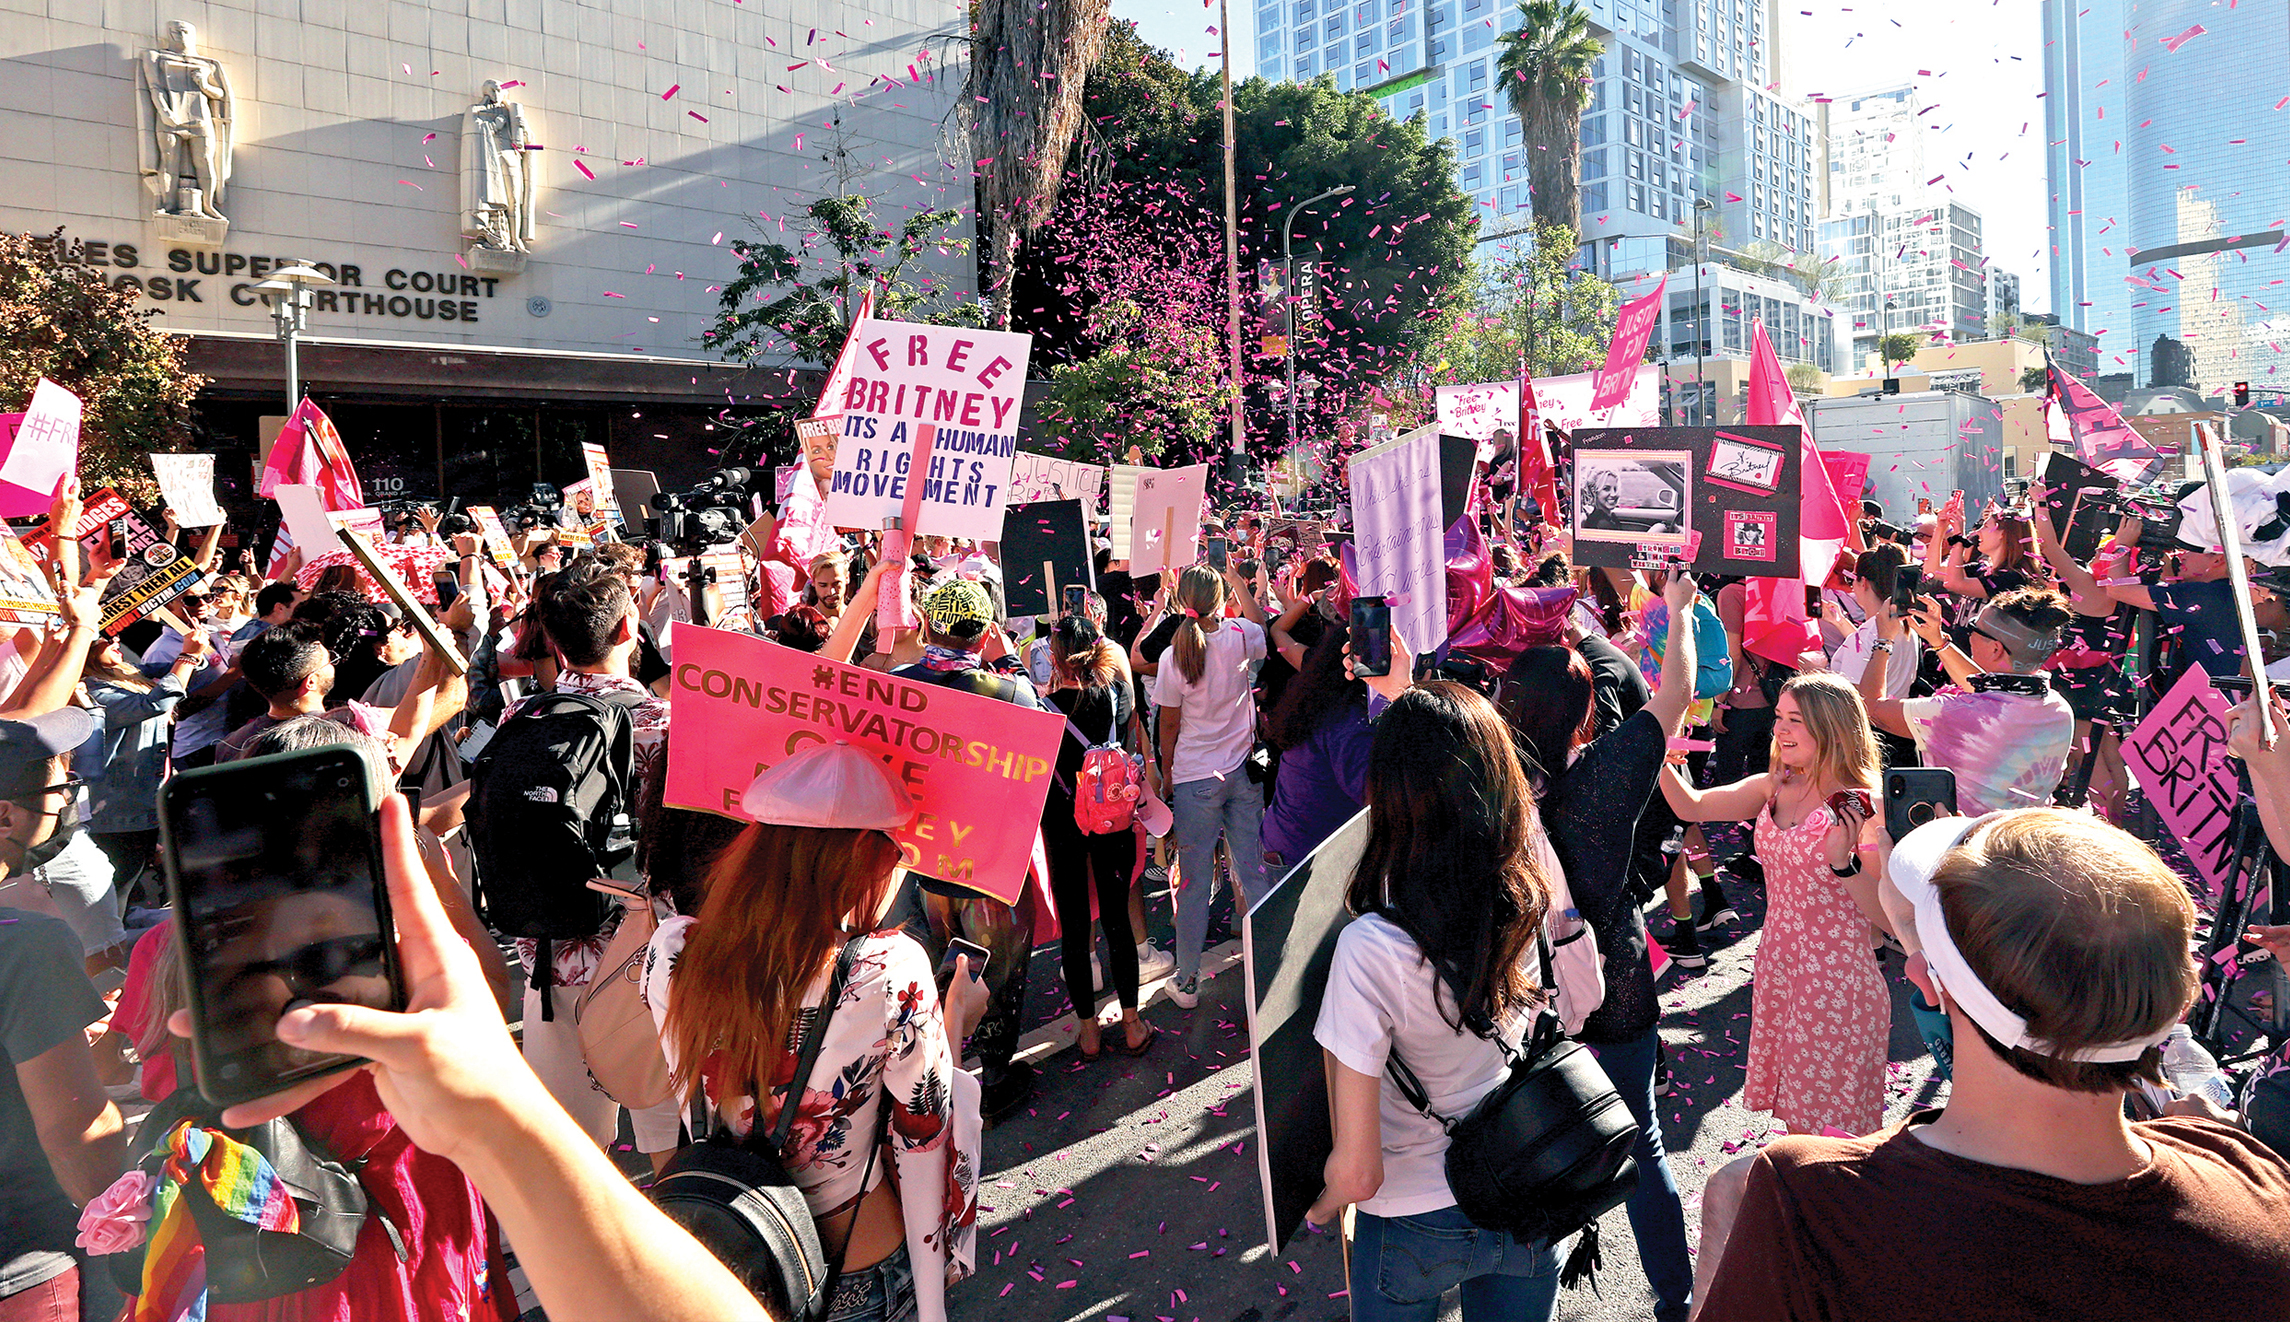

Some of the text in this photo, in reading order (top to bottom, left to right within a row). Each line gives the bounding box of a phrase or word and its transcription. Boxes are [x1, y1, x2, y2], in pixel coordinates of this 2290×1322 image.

[230, 283, 478, 322] CRTHOUSE
[385, 269, 499, 297] COURT
[1301, 261, 1314, 321] OPERA
[867, 335, 1013, 390] FREE
[845, 377, 1014, 429] BRITNEY
[1459, 395, 1478, 406] Free
[801, 420, 828, 438] FREE
[844, 415, 1015, 458] ITS A HUMAN
[1561, 418, 1583, 431] Free
[372, 477, 404, 491] 110
[856, 448, 985, 484] RIGHTS
[1020, 455, 1102, 494] JUSTICE
[831, 470, 998, 508] MOVEMENT
[76, 497, 128, 536] UDGES
[134, 574, 172, 598] THEM
[168, 560, 192, 577] ALL
[812, 664, 928, 713] #END
[676, 663, 1049, 784] CONSERVATORSHIP
